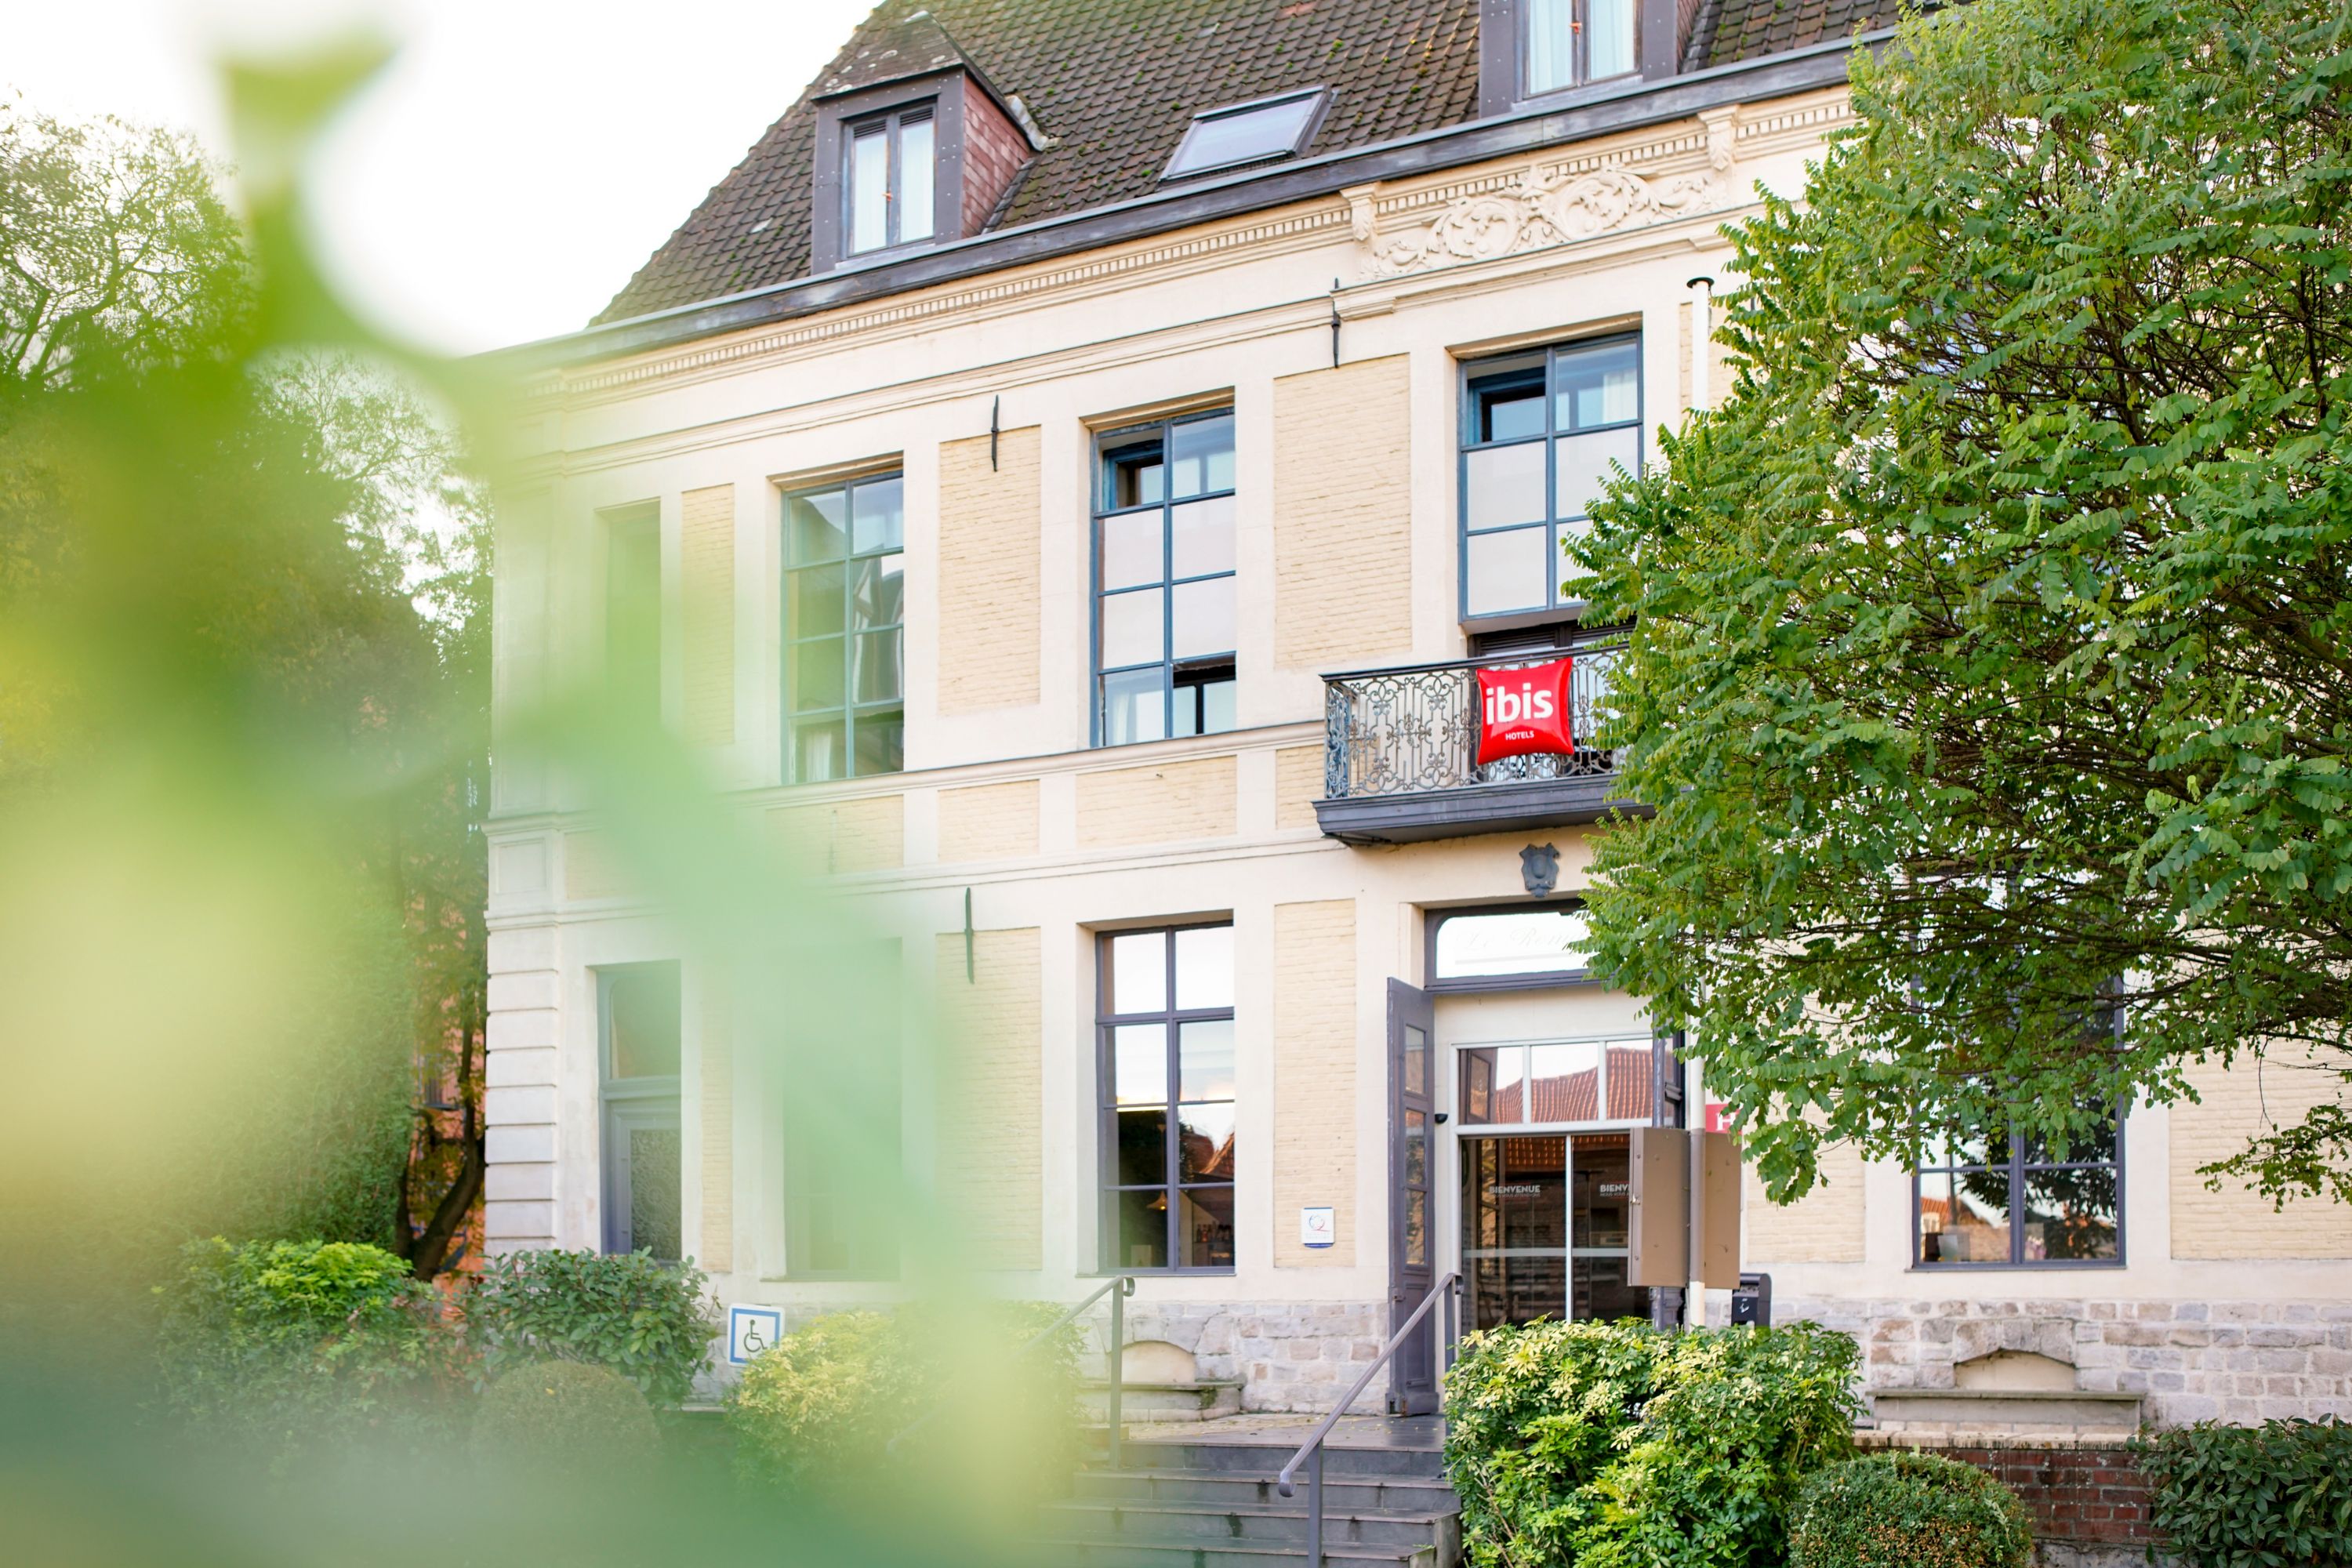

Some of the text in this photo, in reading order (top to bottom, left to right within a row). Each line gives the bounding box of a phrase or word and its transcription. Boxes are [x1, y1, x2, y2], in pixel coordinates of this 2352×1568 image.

[1486, 683, 1553, 725] ibis
[1505, 730, 1534, 740] HOTELS
[1490, 1185, 1541, 1193] BIENVENUE
[1600, 1184, 1630, 1192] BIENV
